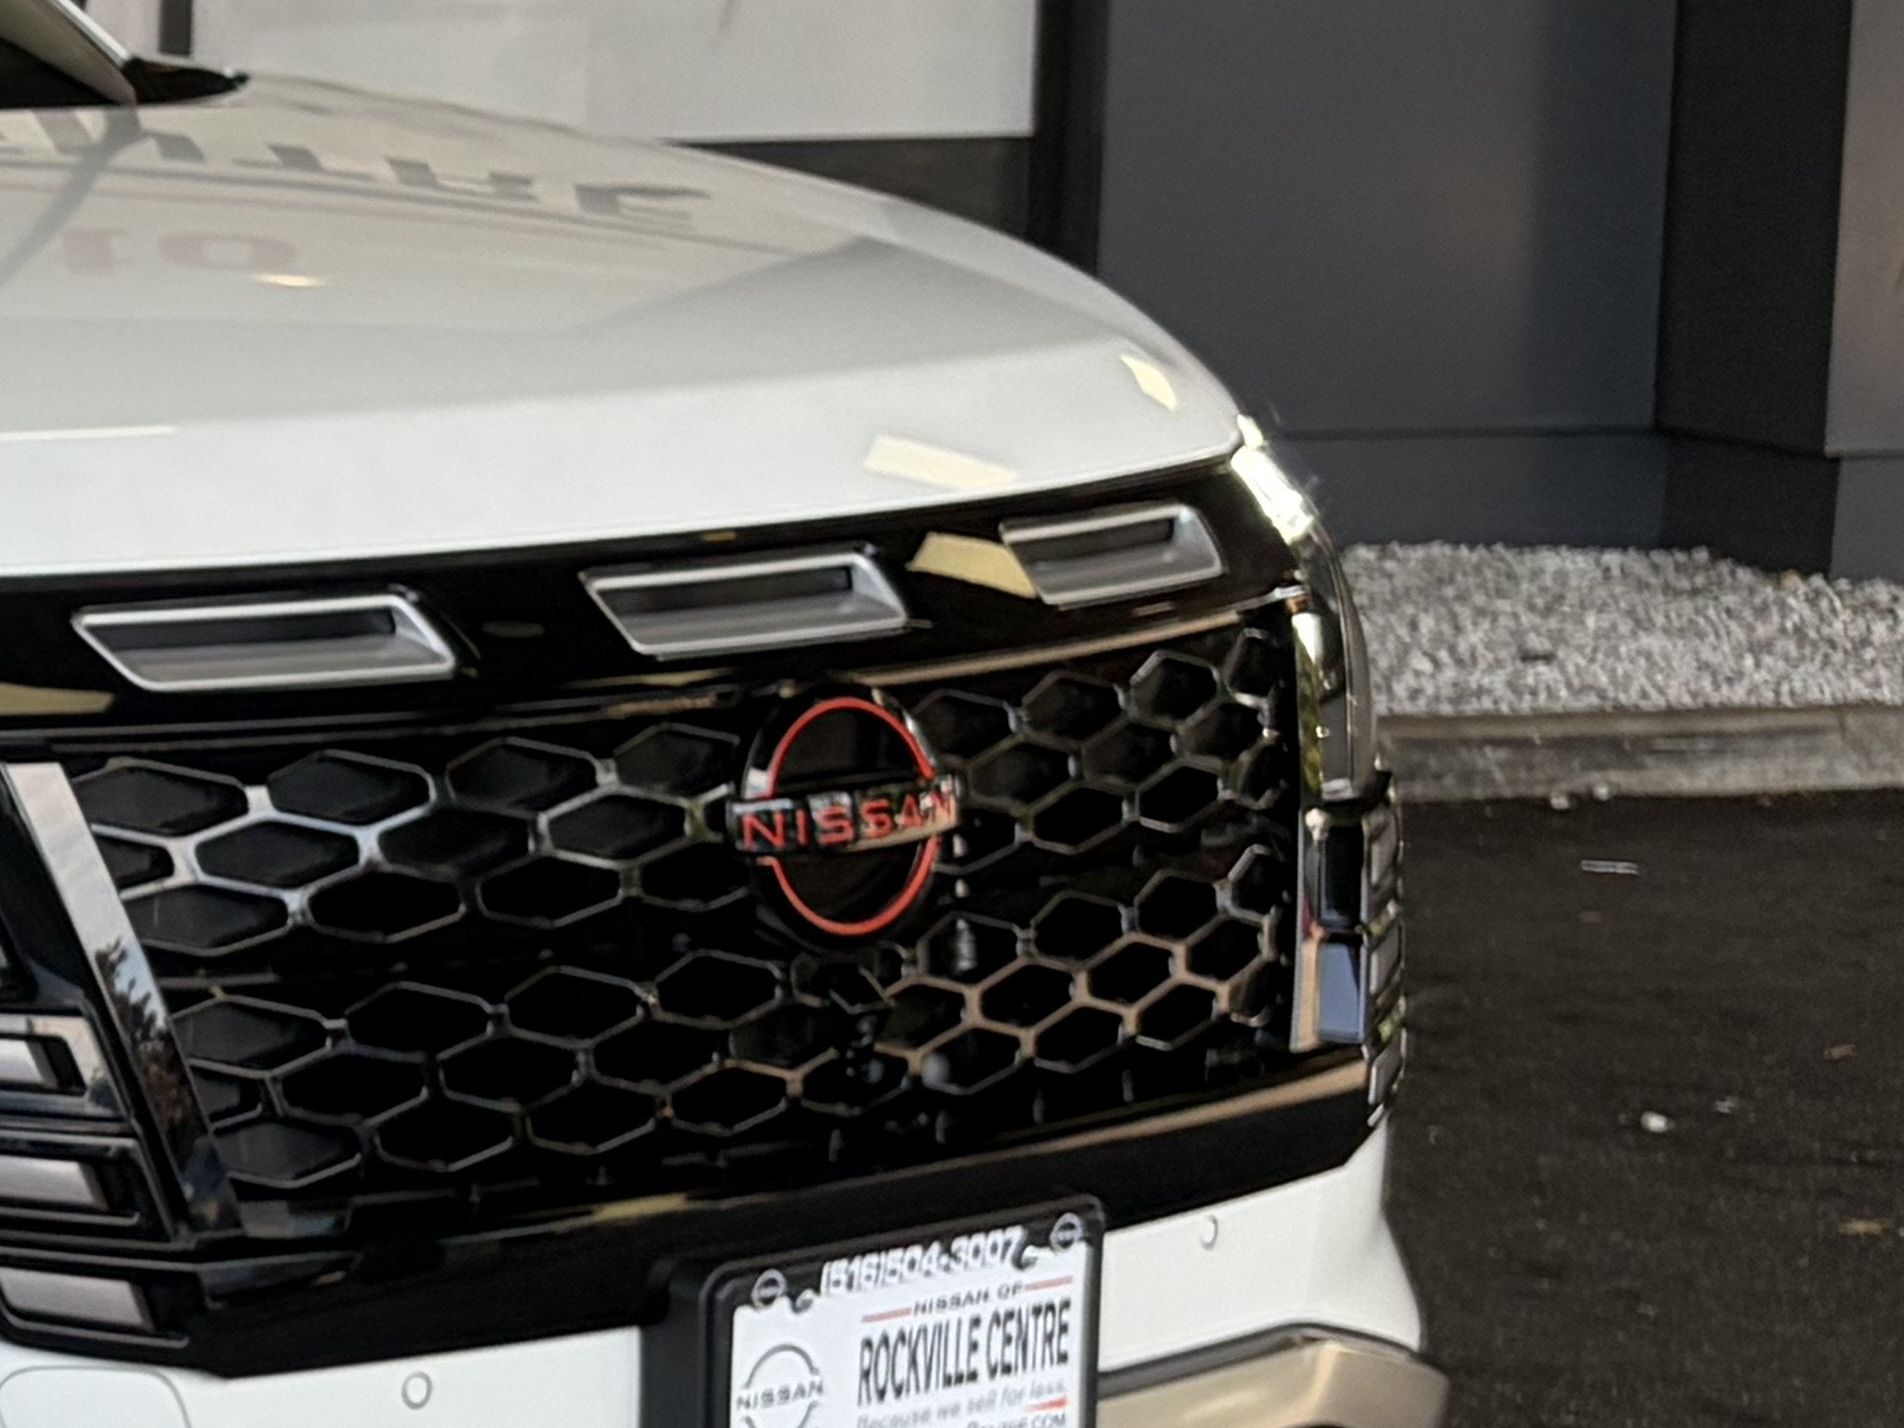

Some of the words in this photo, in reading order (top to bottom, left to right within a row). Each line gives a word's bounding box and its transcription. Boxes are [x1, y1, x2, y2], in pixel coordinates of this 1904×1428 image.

[743, 790, 954, 849] NISSAN
[914, 1289, 990, 1317] NISSAN
[857, 1314, 982, 1408] ROCKVILLE
[986, 1298, 1072, 1380] CENTRE
[737, 1379, 823, 1410] NISSAN
